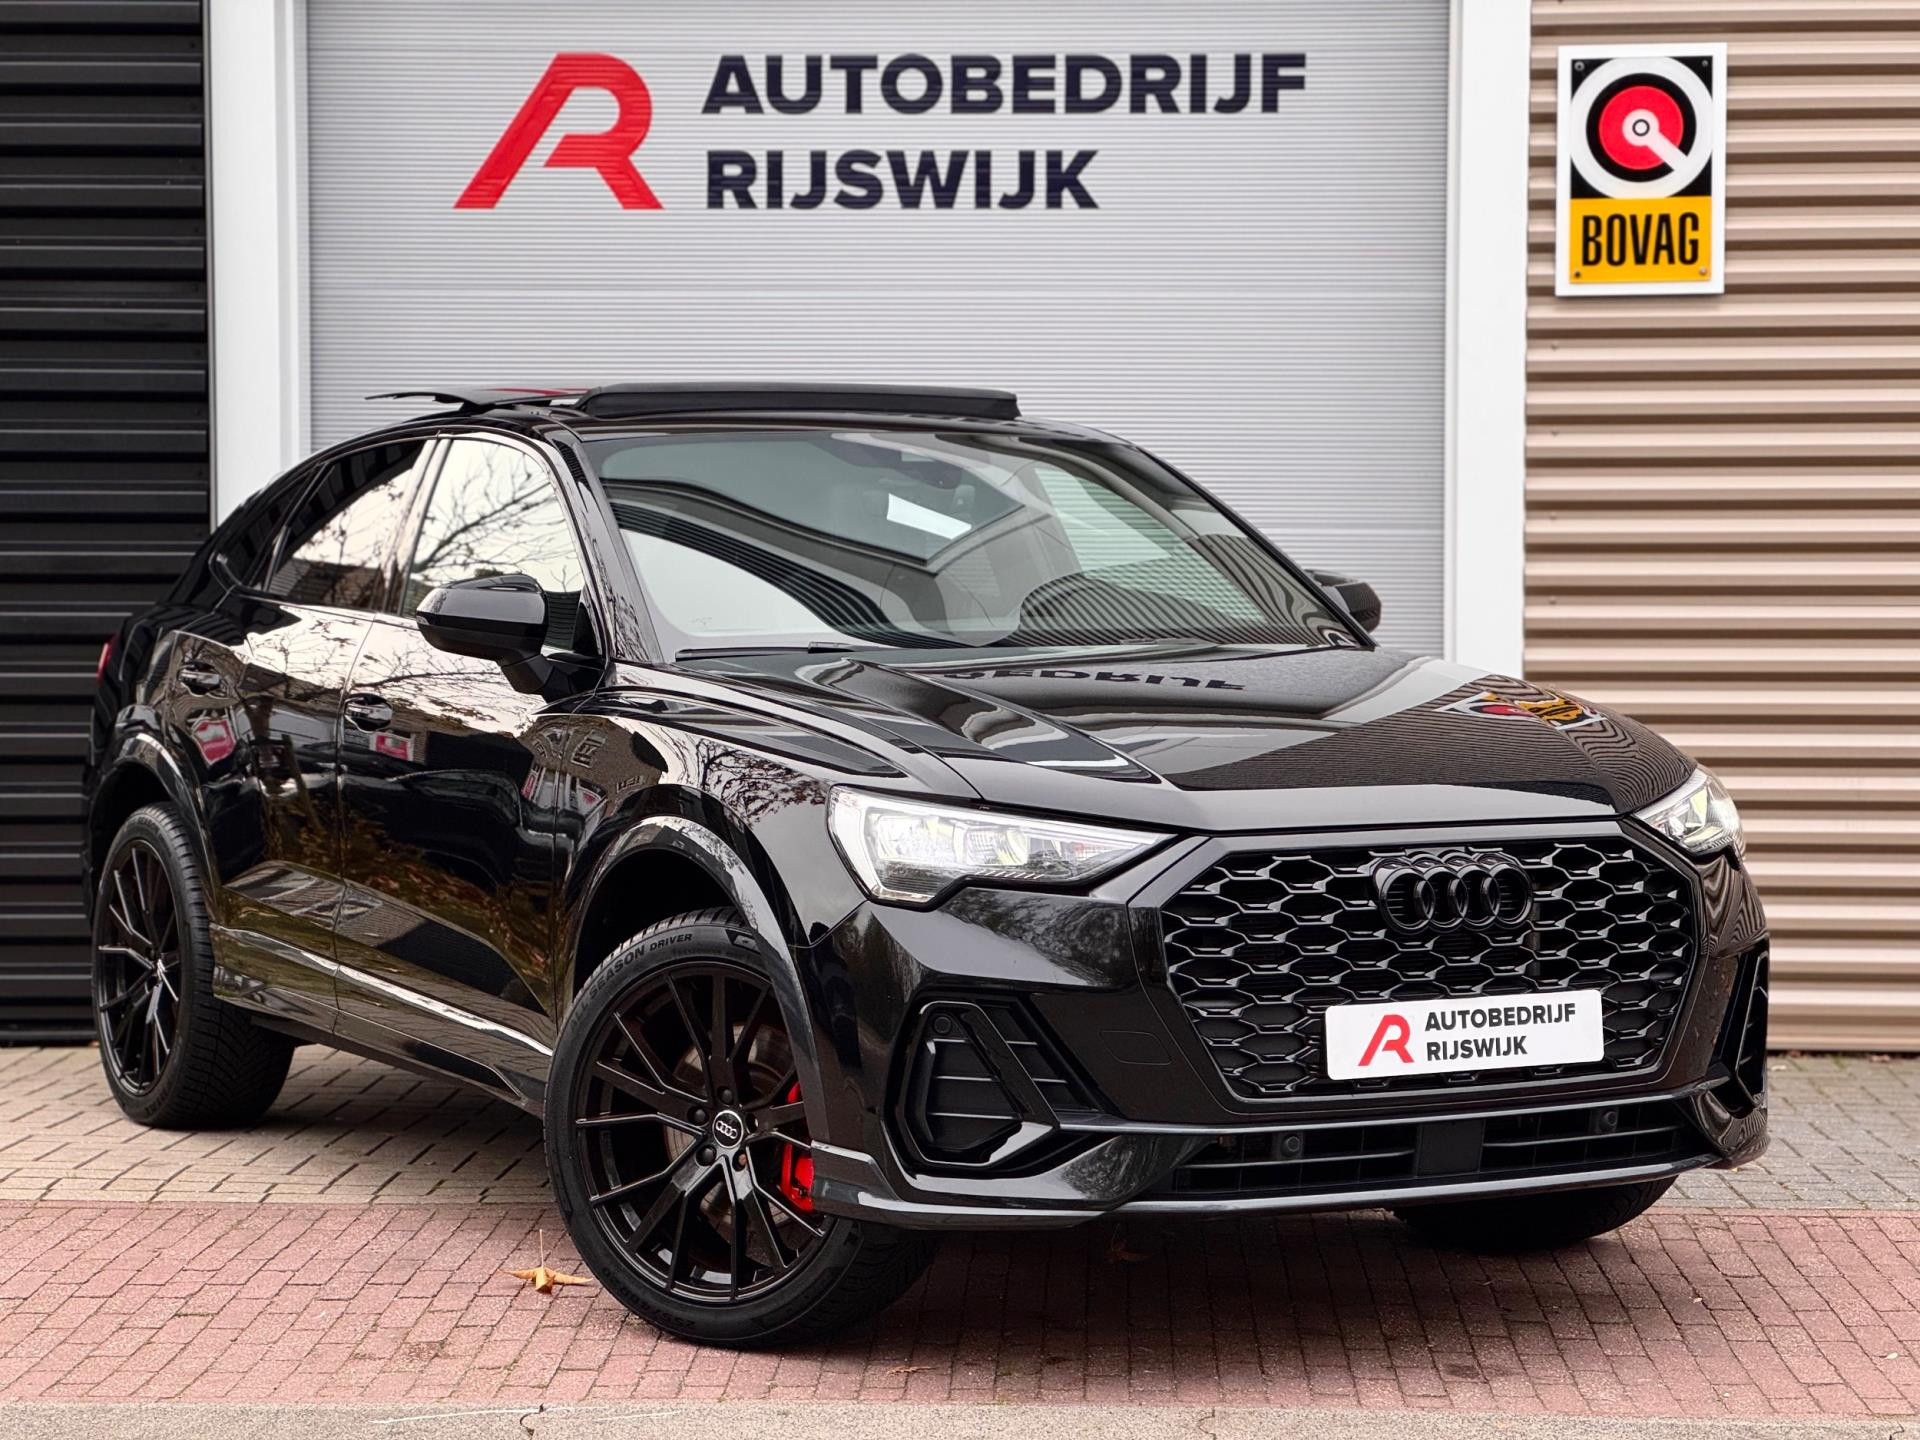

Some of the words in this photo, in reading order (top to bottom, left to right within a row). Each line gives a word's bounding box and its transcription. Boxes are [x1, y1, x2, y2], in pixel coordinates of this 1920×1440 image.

[702, 54, 1305, 114] AUTOBEDRIJF
[707, 150, 1097, 210] RIJSWIJK
[1582, 212, 1699, 266] BOVAG
[589, 945, 645, 1000] SEASON
[650, 933, 693, 951] DRIVER
[1425, 1003, 1575, 1031] AUTOBEDRIJF
[1426, 1036, 1528, 1061] RIJSWIJK
